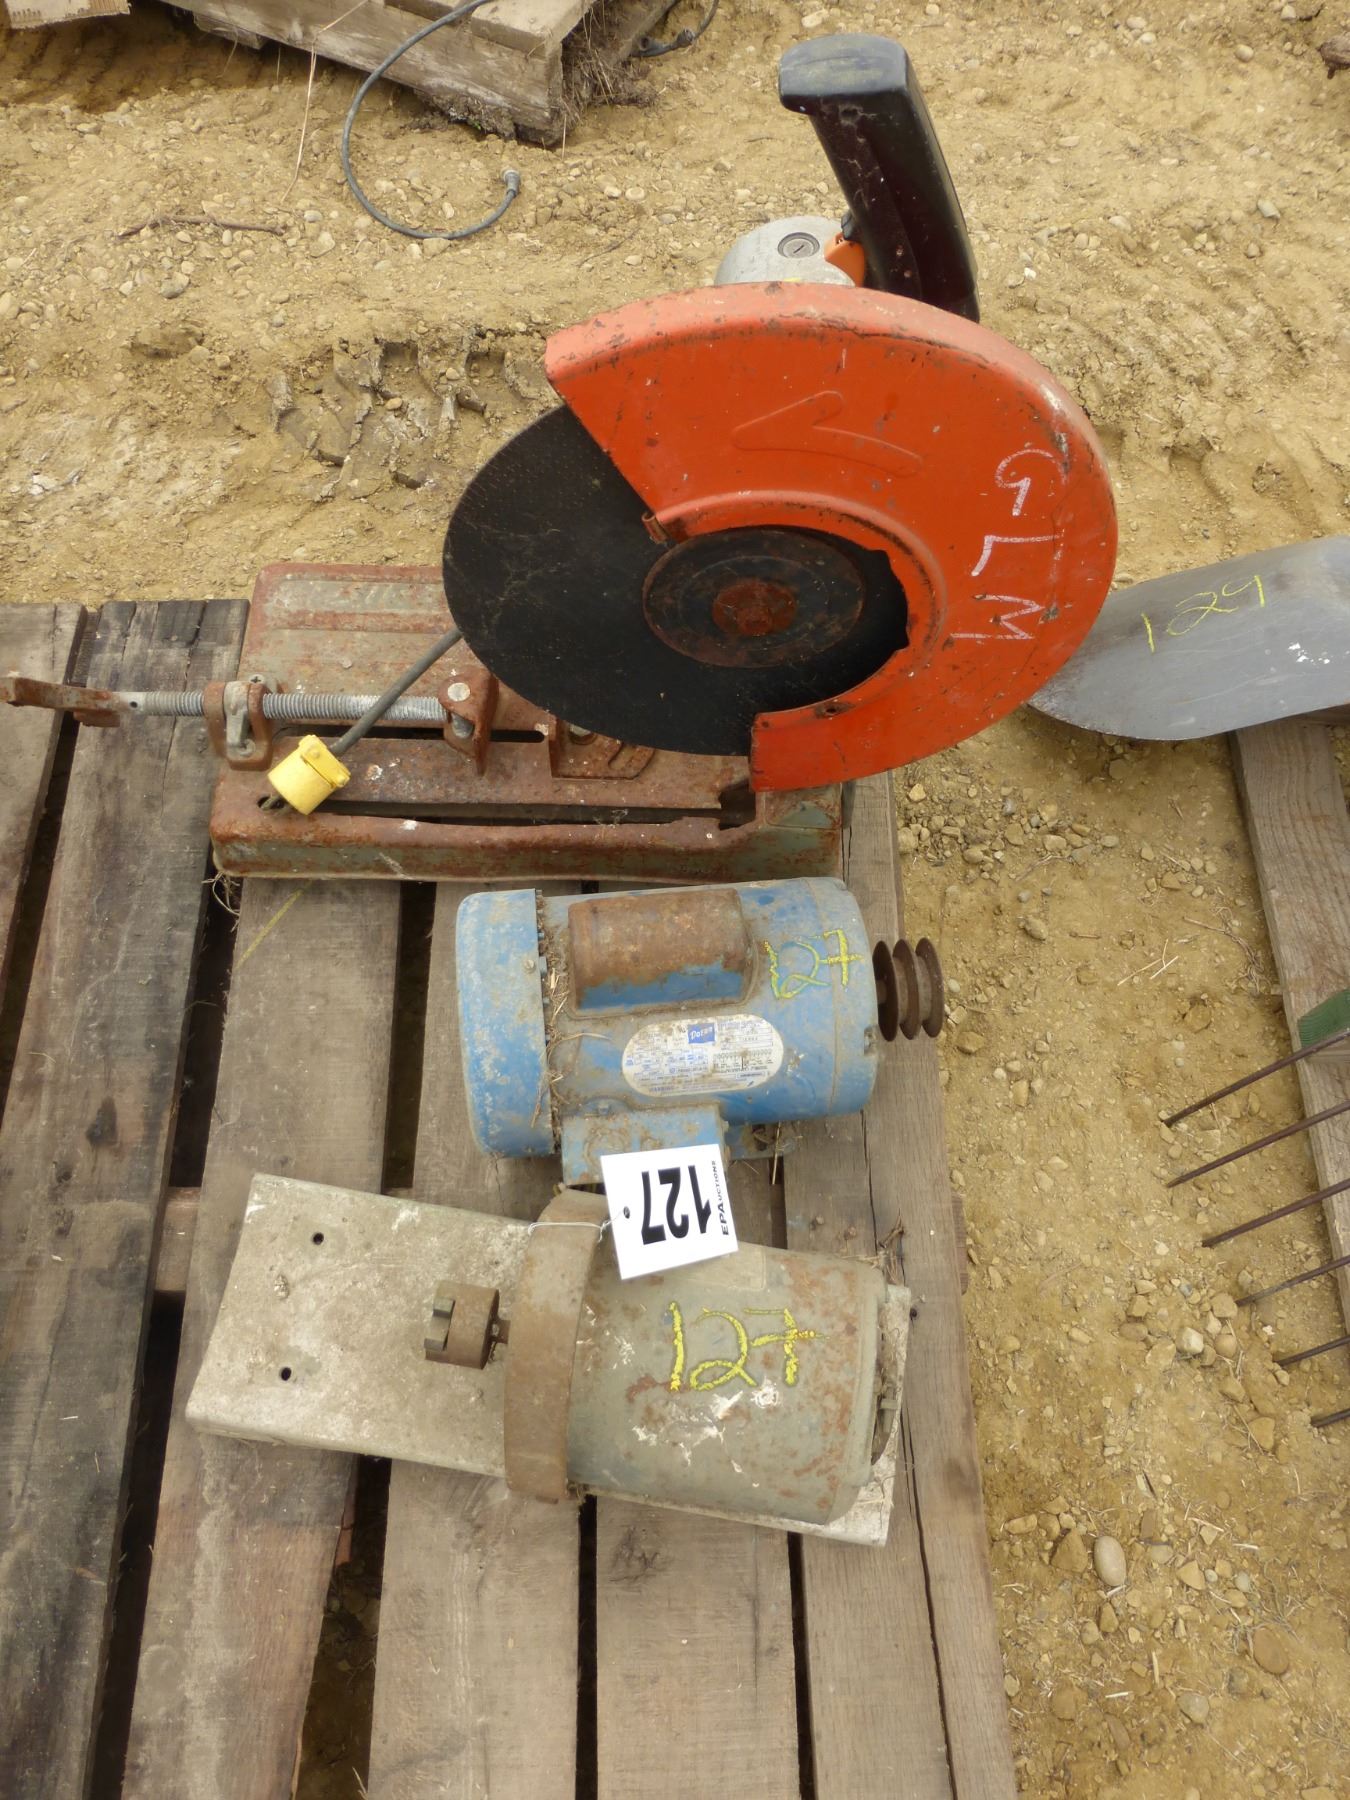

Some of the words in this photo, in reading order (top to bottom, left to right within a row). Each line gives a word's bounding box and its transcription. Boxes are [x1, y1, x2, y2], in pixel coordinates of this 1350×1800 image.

[1142, 575, 1265, 653] 129
[764, 929, 863, 998] 127
[642, 1166, 712, 1245] 127
[669, 1301, 824, 1391] 127
